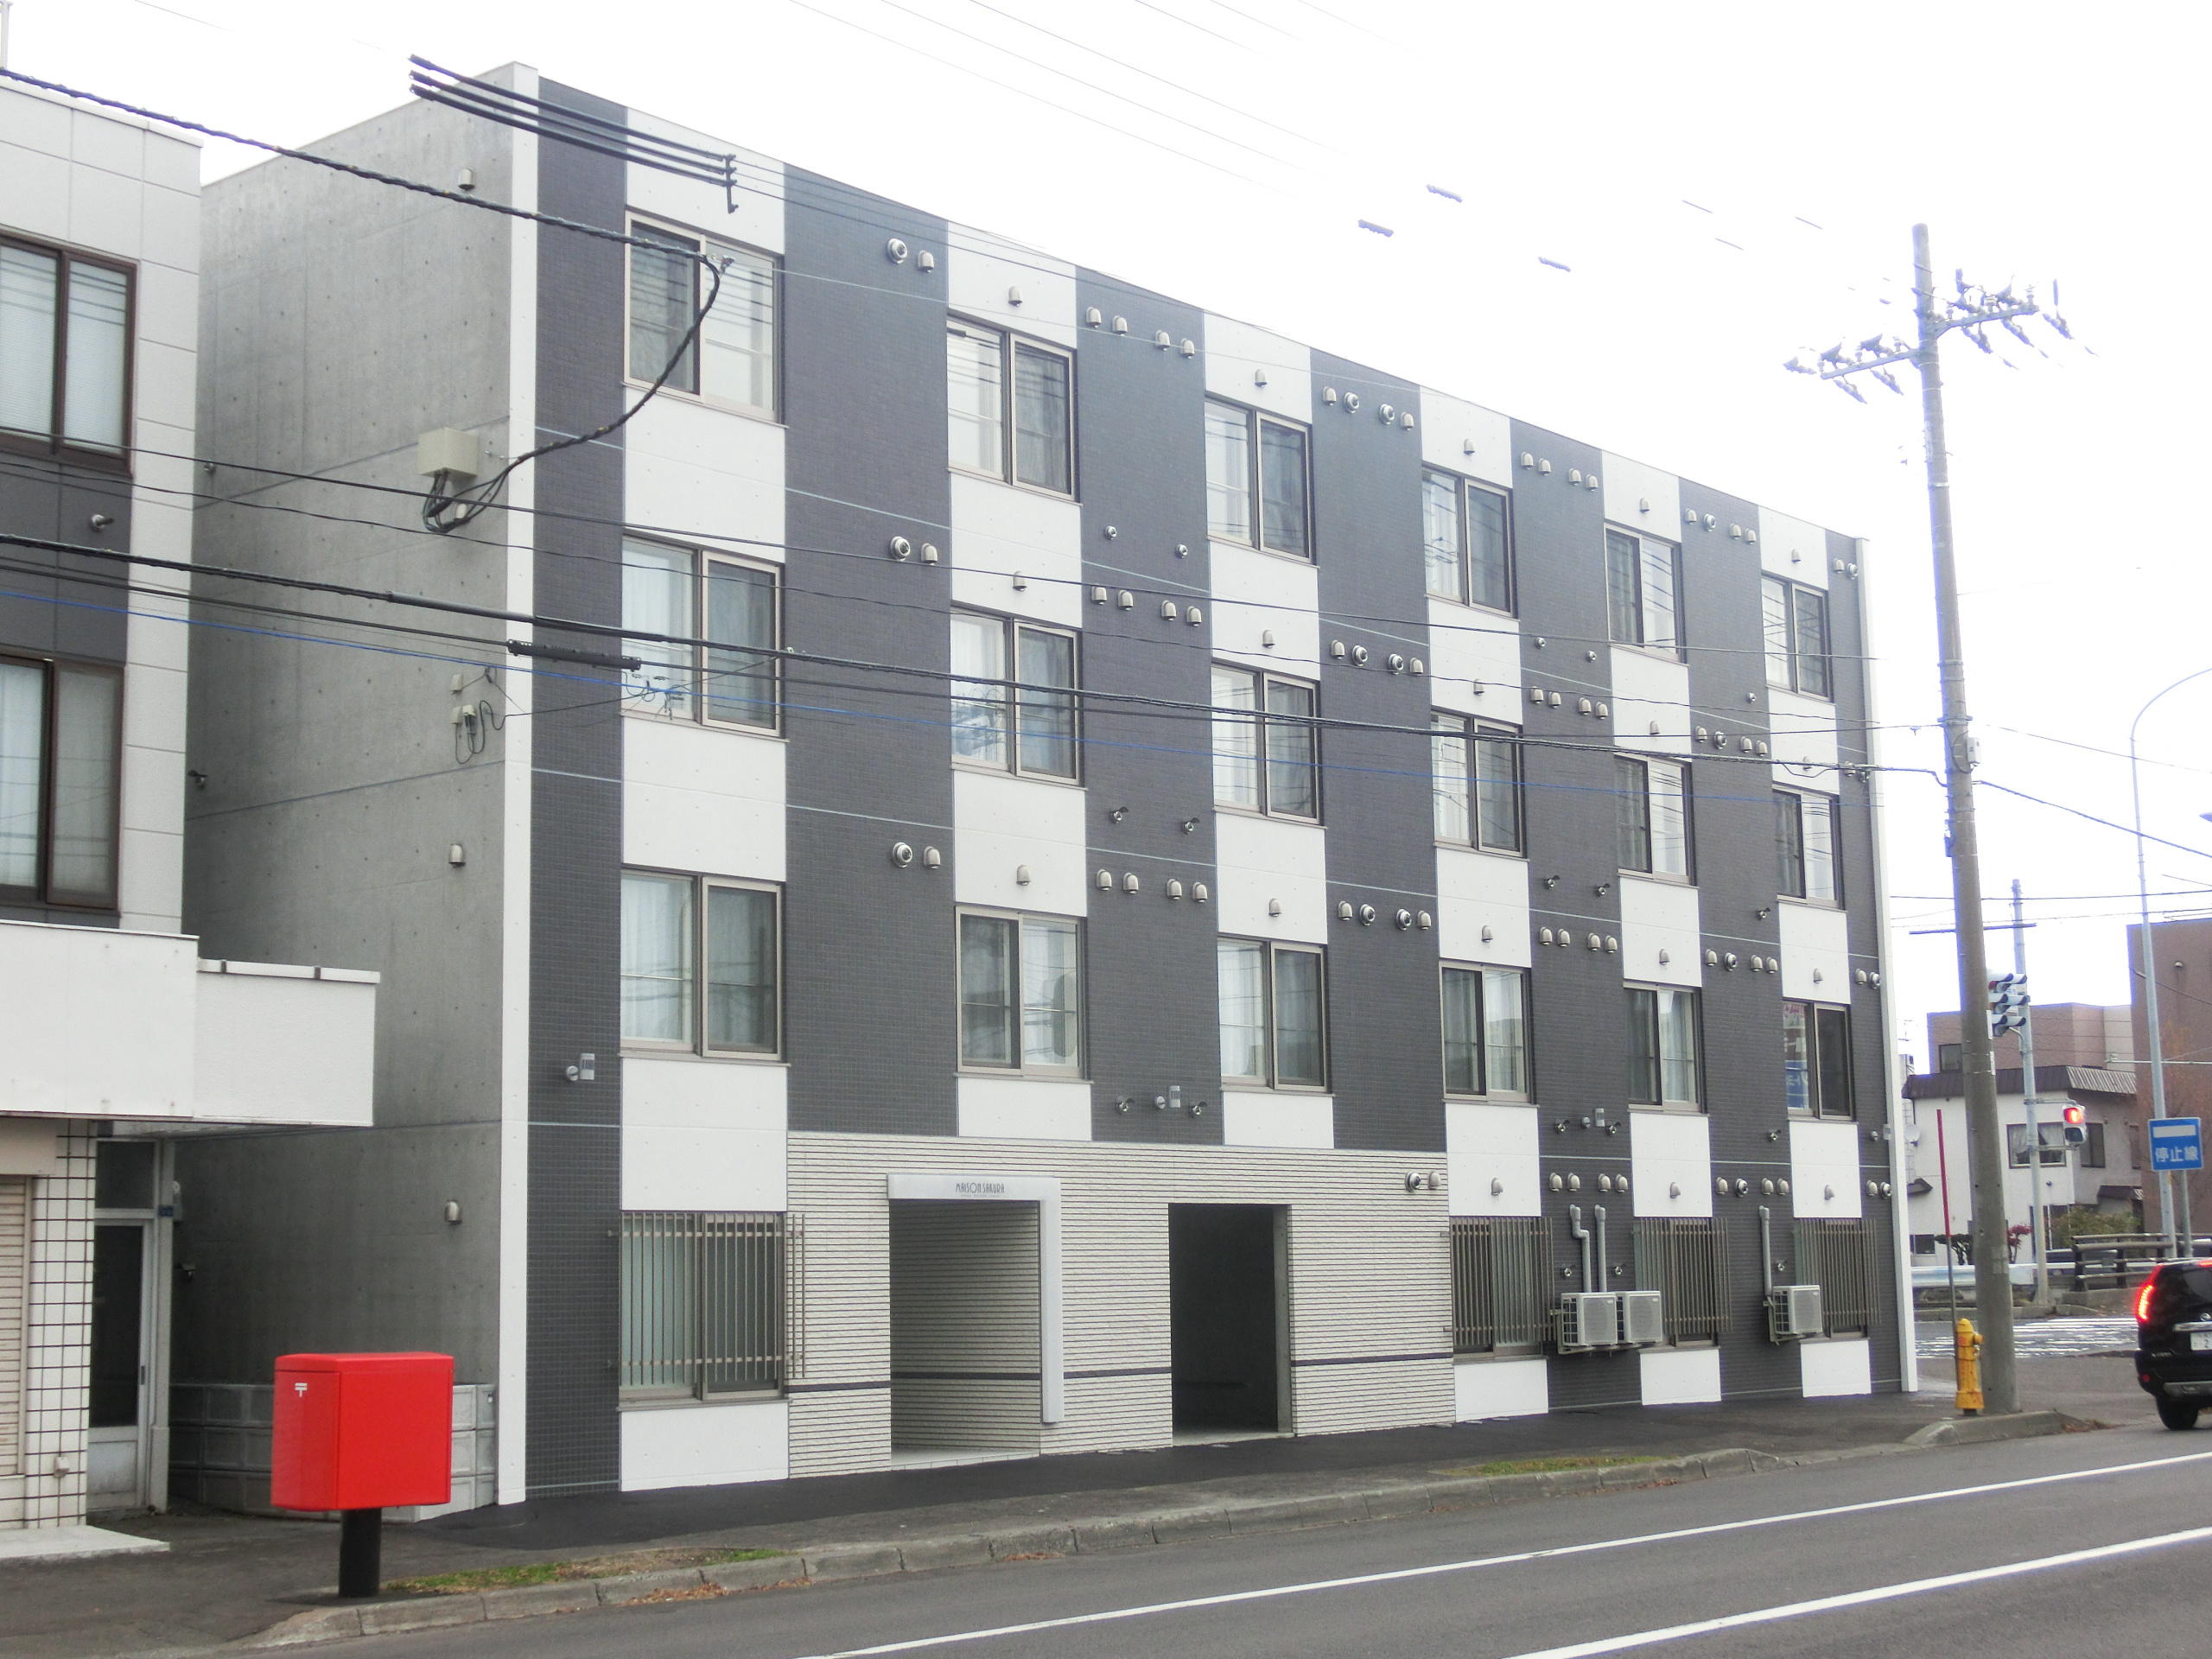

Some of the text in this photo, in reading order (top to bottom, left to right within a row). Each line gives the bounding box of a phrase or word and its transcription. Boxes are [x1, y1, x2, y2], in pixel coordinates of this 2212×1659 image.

[2155, 1145, 2198, 1163] 停止線
[955, 1181, 1005, 1193] MAISON SAKURA
